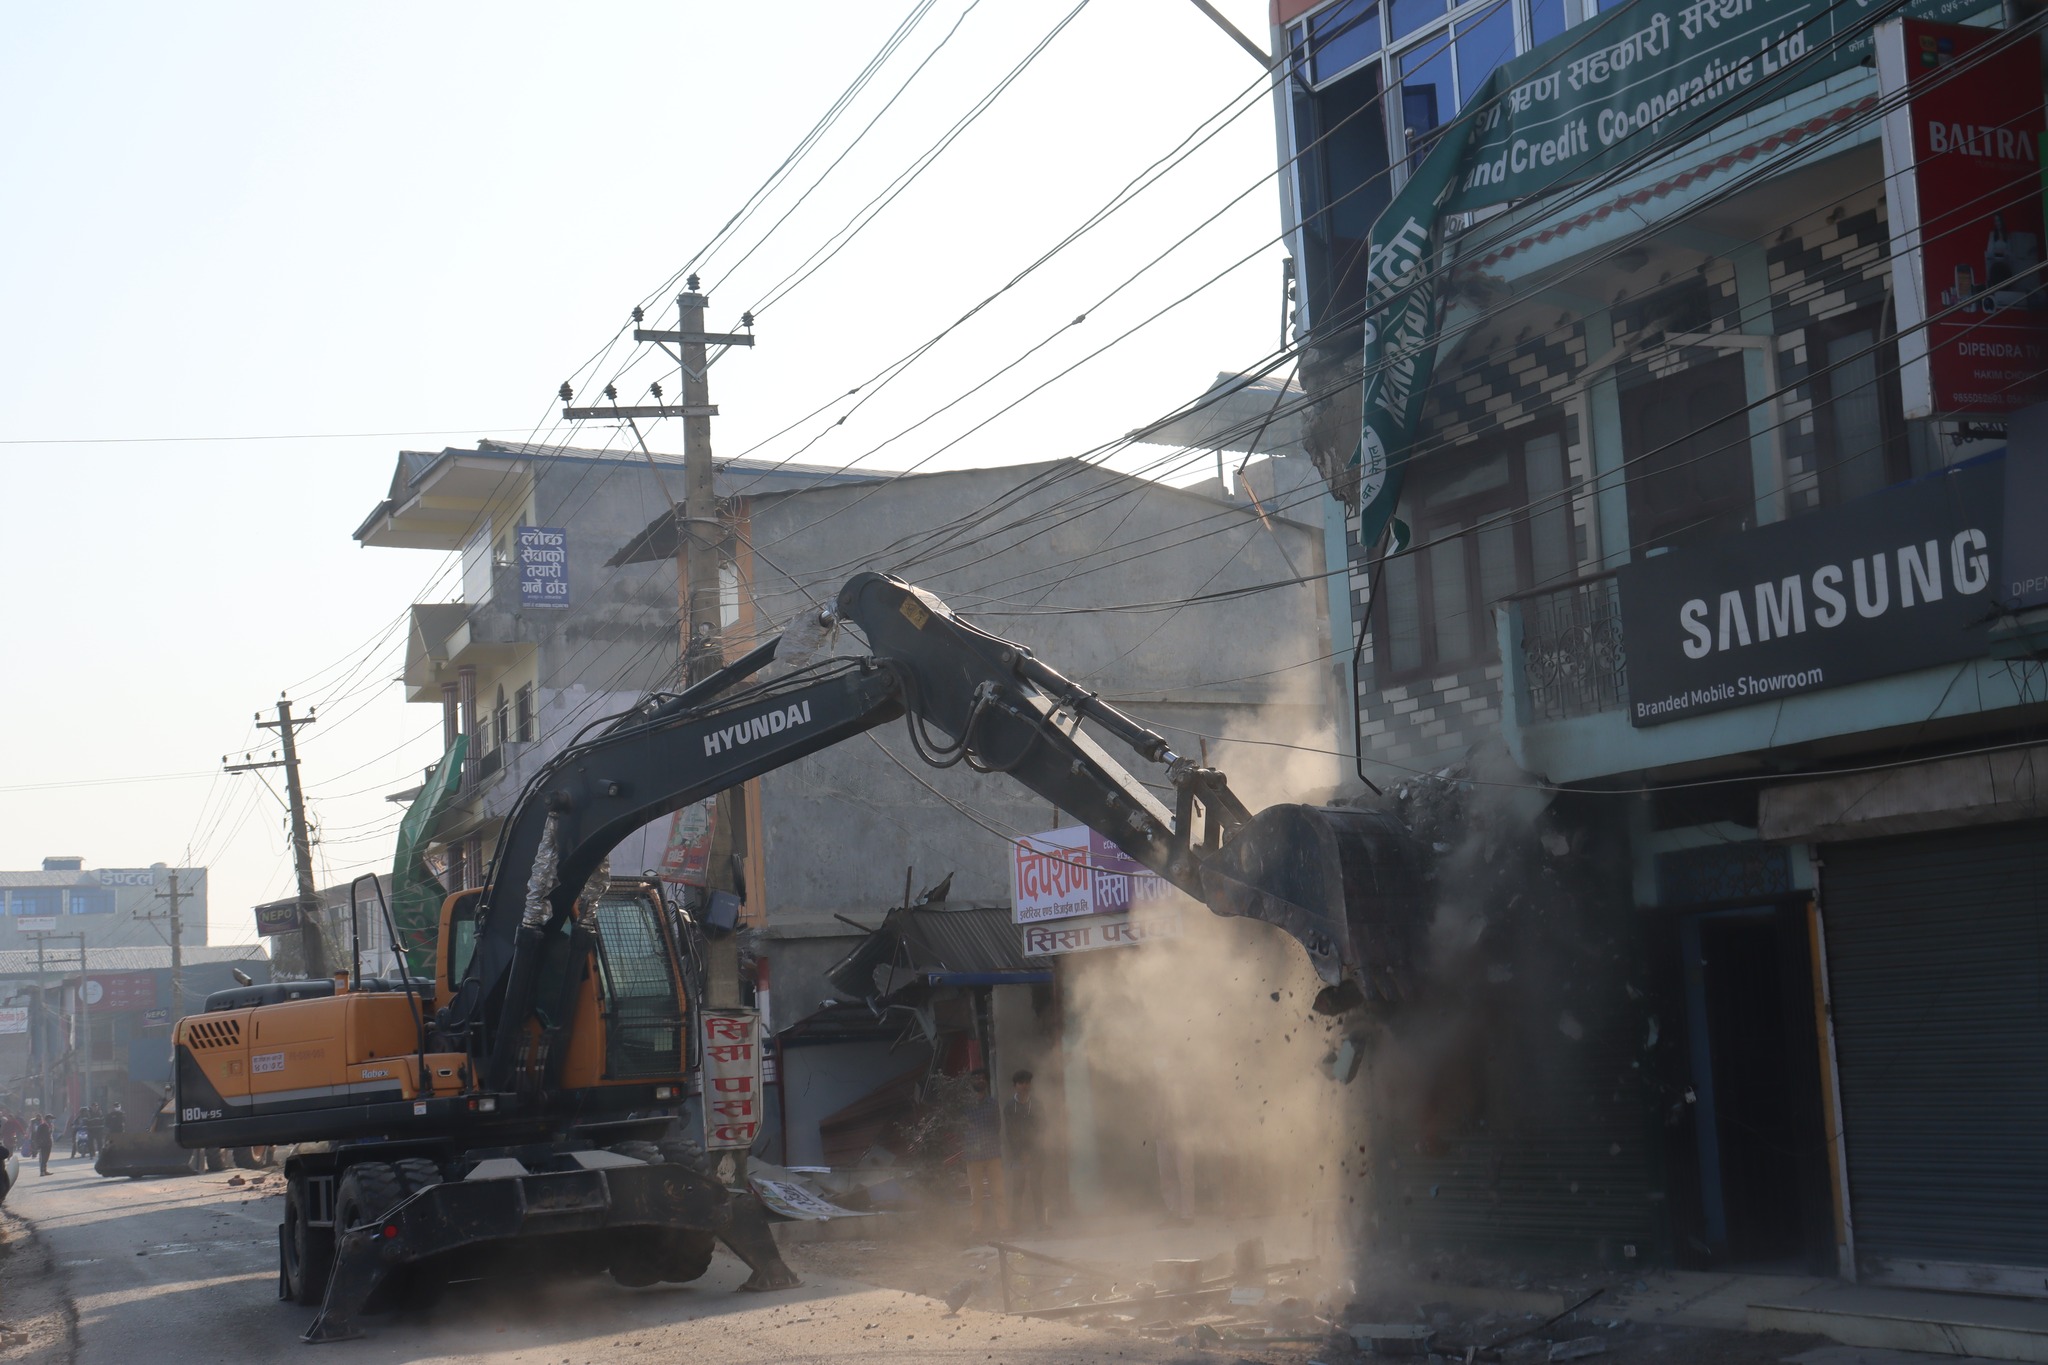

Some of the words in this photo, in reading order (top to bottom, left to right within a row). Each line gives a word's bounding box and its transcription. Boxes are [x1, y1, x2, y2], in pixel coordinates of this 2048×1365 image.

[1567, 12, 1672, 92] सहकारी
[1510, 117, 1590, 174] Credit
[1597, 52, 1754, 146] Co-operative
[1761, 22, 1814, 75] Ltd.
[1929, 121, 2035, 162] BALTRA
[1958, 342, 2023, 358] DIPENDRA
[1974, 370, 2002, 380] HAKIM
[521, 529, 564, 546] लोक
[526, 562, 561, 578] तयारी
[1679, 527, 1990, 660] SAMSUNG
[1637, 686, 1689, 718] Branded
[1691, 683, 1735, 707] Mobile
[1737, 665, 1824, 696] Showroom
[703, 699, 812, 757] HYUNDAI
[1095, 865, 1129, 907] सिसा
[1026, 927, 1092, 952] सिसा
